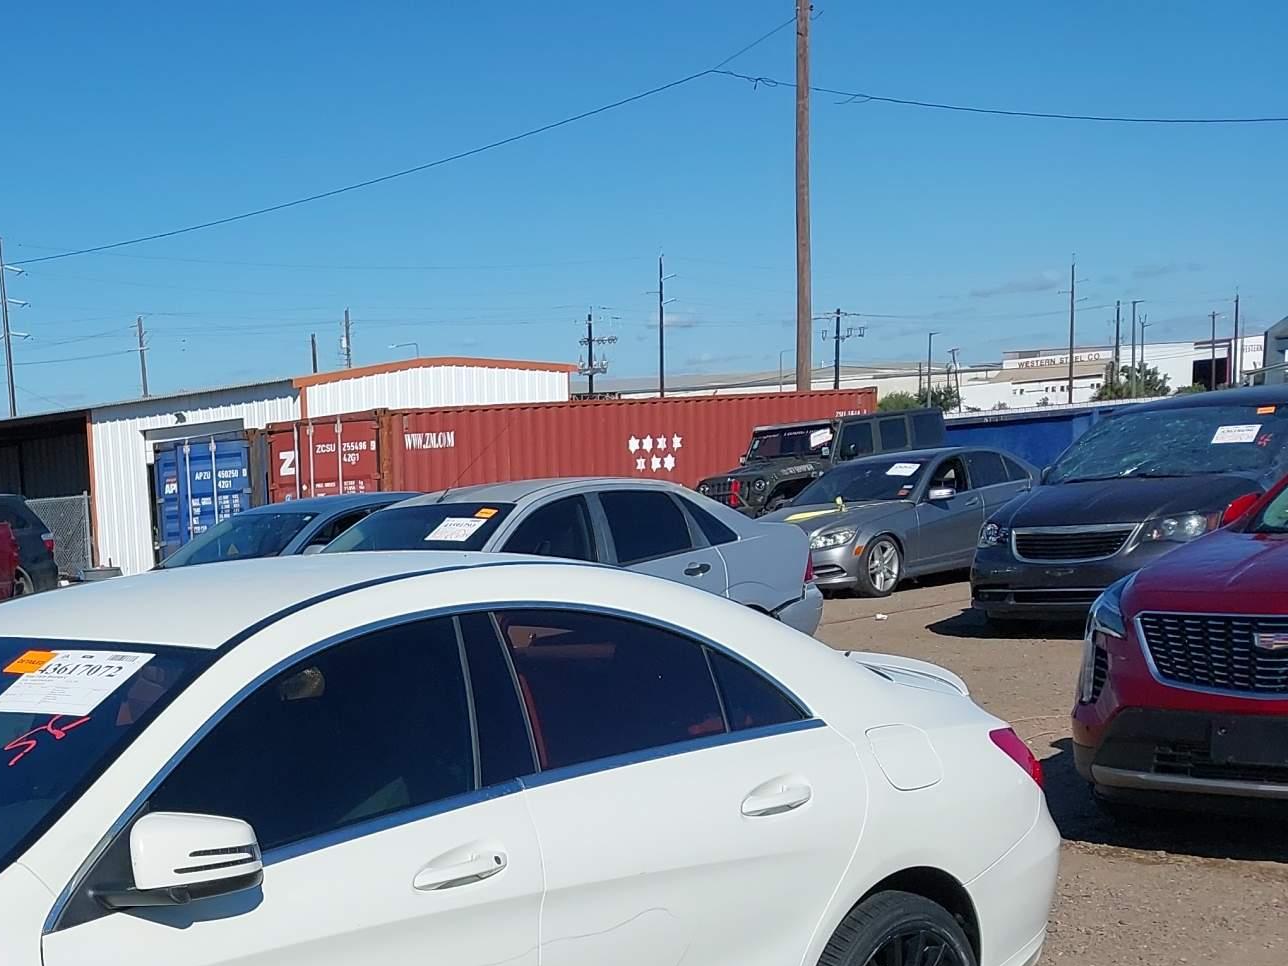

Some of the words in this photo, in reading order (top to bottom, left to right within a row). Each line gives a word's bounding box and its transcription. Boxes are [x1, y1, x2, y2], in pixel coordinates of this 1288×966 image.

[1017, 358, 1056, 369] WESTERN
[1059, 354, 1083, 365] STEL
[315, 443, 335, 453] ZCSU
[195, 471, 211, 480] APZU
[39, 663, 123, 678] 43617072
